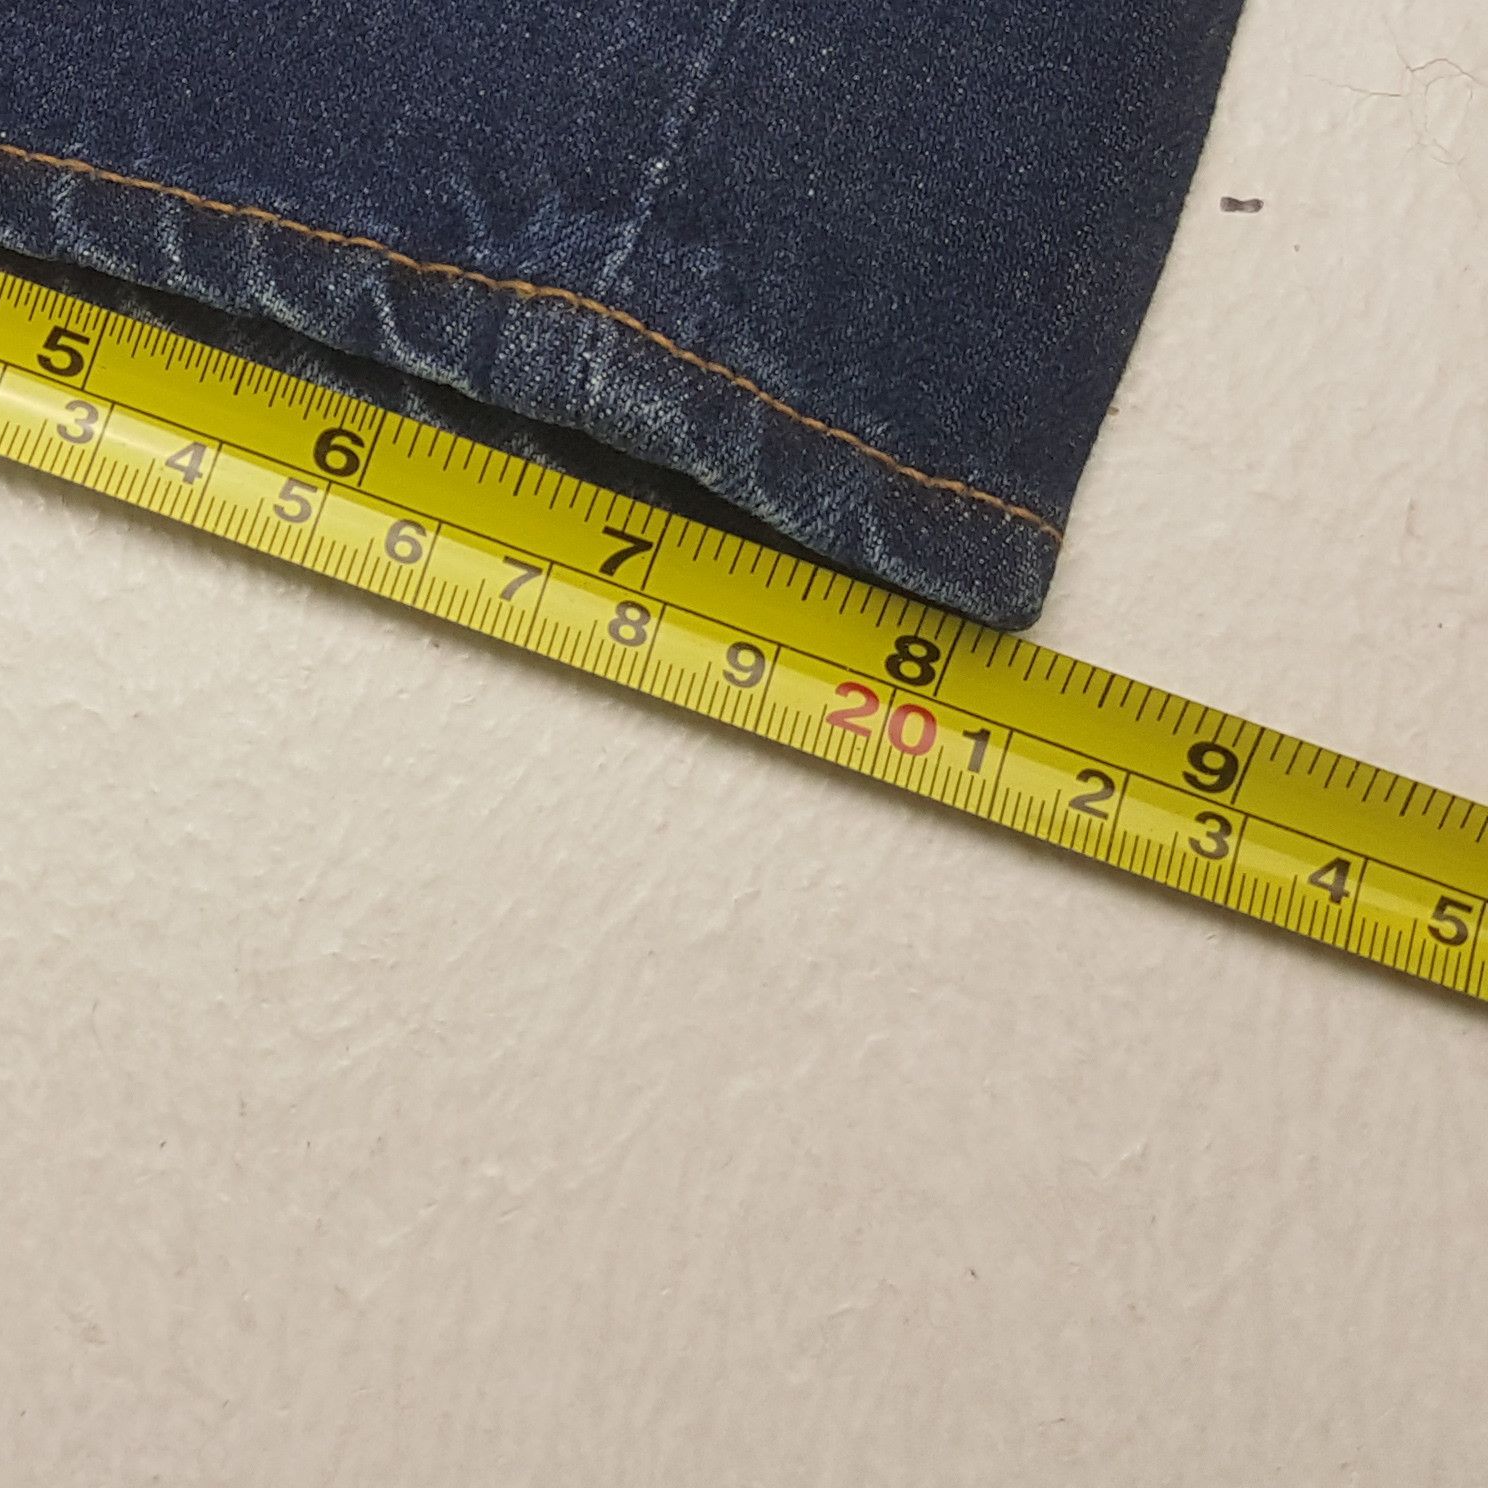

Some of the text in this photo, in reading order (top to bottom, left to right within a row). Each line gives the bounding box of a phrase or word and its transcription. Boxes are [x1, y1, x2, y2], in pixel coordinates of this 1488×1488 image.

[36, 326, 92, 378] 5
[313, 427, 366, 478] 6
[599, 526, 654, 578] 7
[885, 635, 941, 686] 8
[1182, 741, 1240, 793] 9
[57, 399, 99, 444] 3
[165, 440, 209, 485] 4
[272, 478, 319, 524] 5
[384, 518, 427, 564] 6
[498, 556, 543, 601] 7
[607, 600, 651, 647] 8
[722, 641, 767, 688] 9
[825, 681, 937, 757] 20
[962, 728, 992, 774] 1
[1068, 769, 1116, 821] 2
[1188, 812, 1233, 860] 3
[1308, 857, 1351, 904] 4
[1427, 896, 1474, 946] 5
